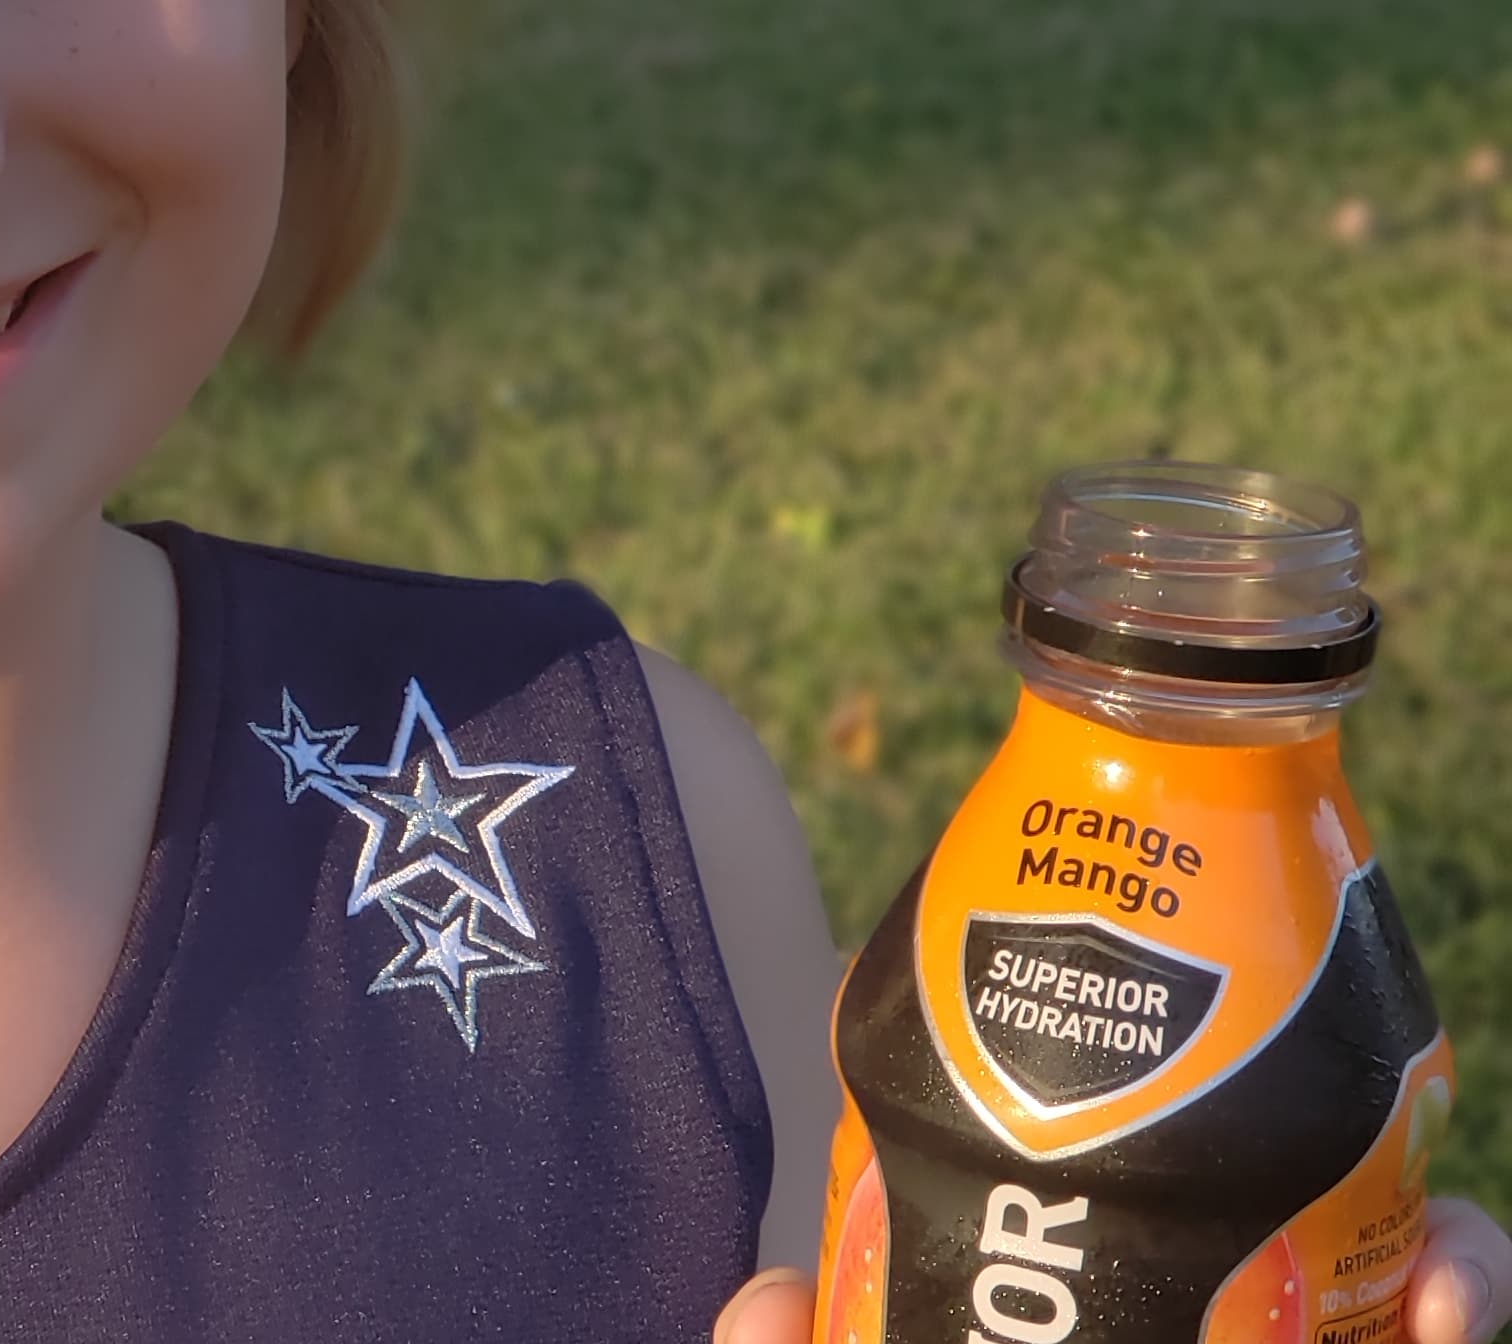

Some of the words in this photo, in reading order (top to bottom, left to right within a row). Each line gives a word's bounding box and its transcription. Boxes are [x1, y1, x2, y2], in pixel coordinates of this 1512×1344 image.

[1020, 799, 1203, 877] Orange
[1016, 846, 1181, 918] Mango
[988, 949, 1170, 1018] SUPERIOR
[976, 987, 1164, 1056] HYDRATION
[1358, 1221, 1377, 1245] NO
